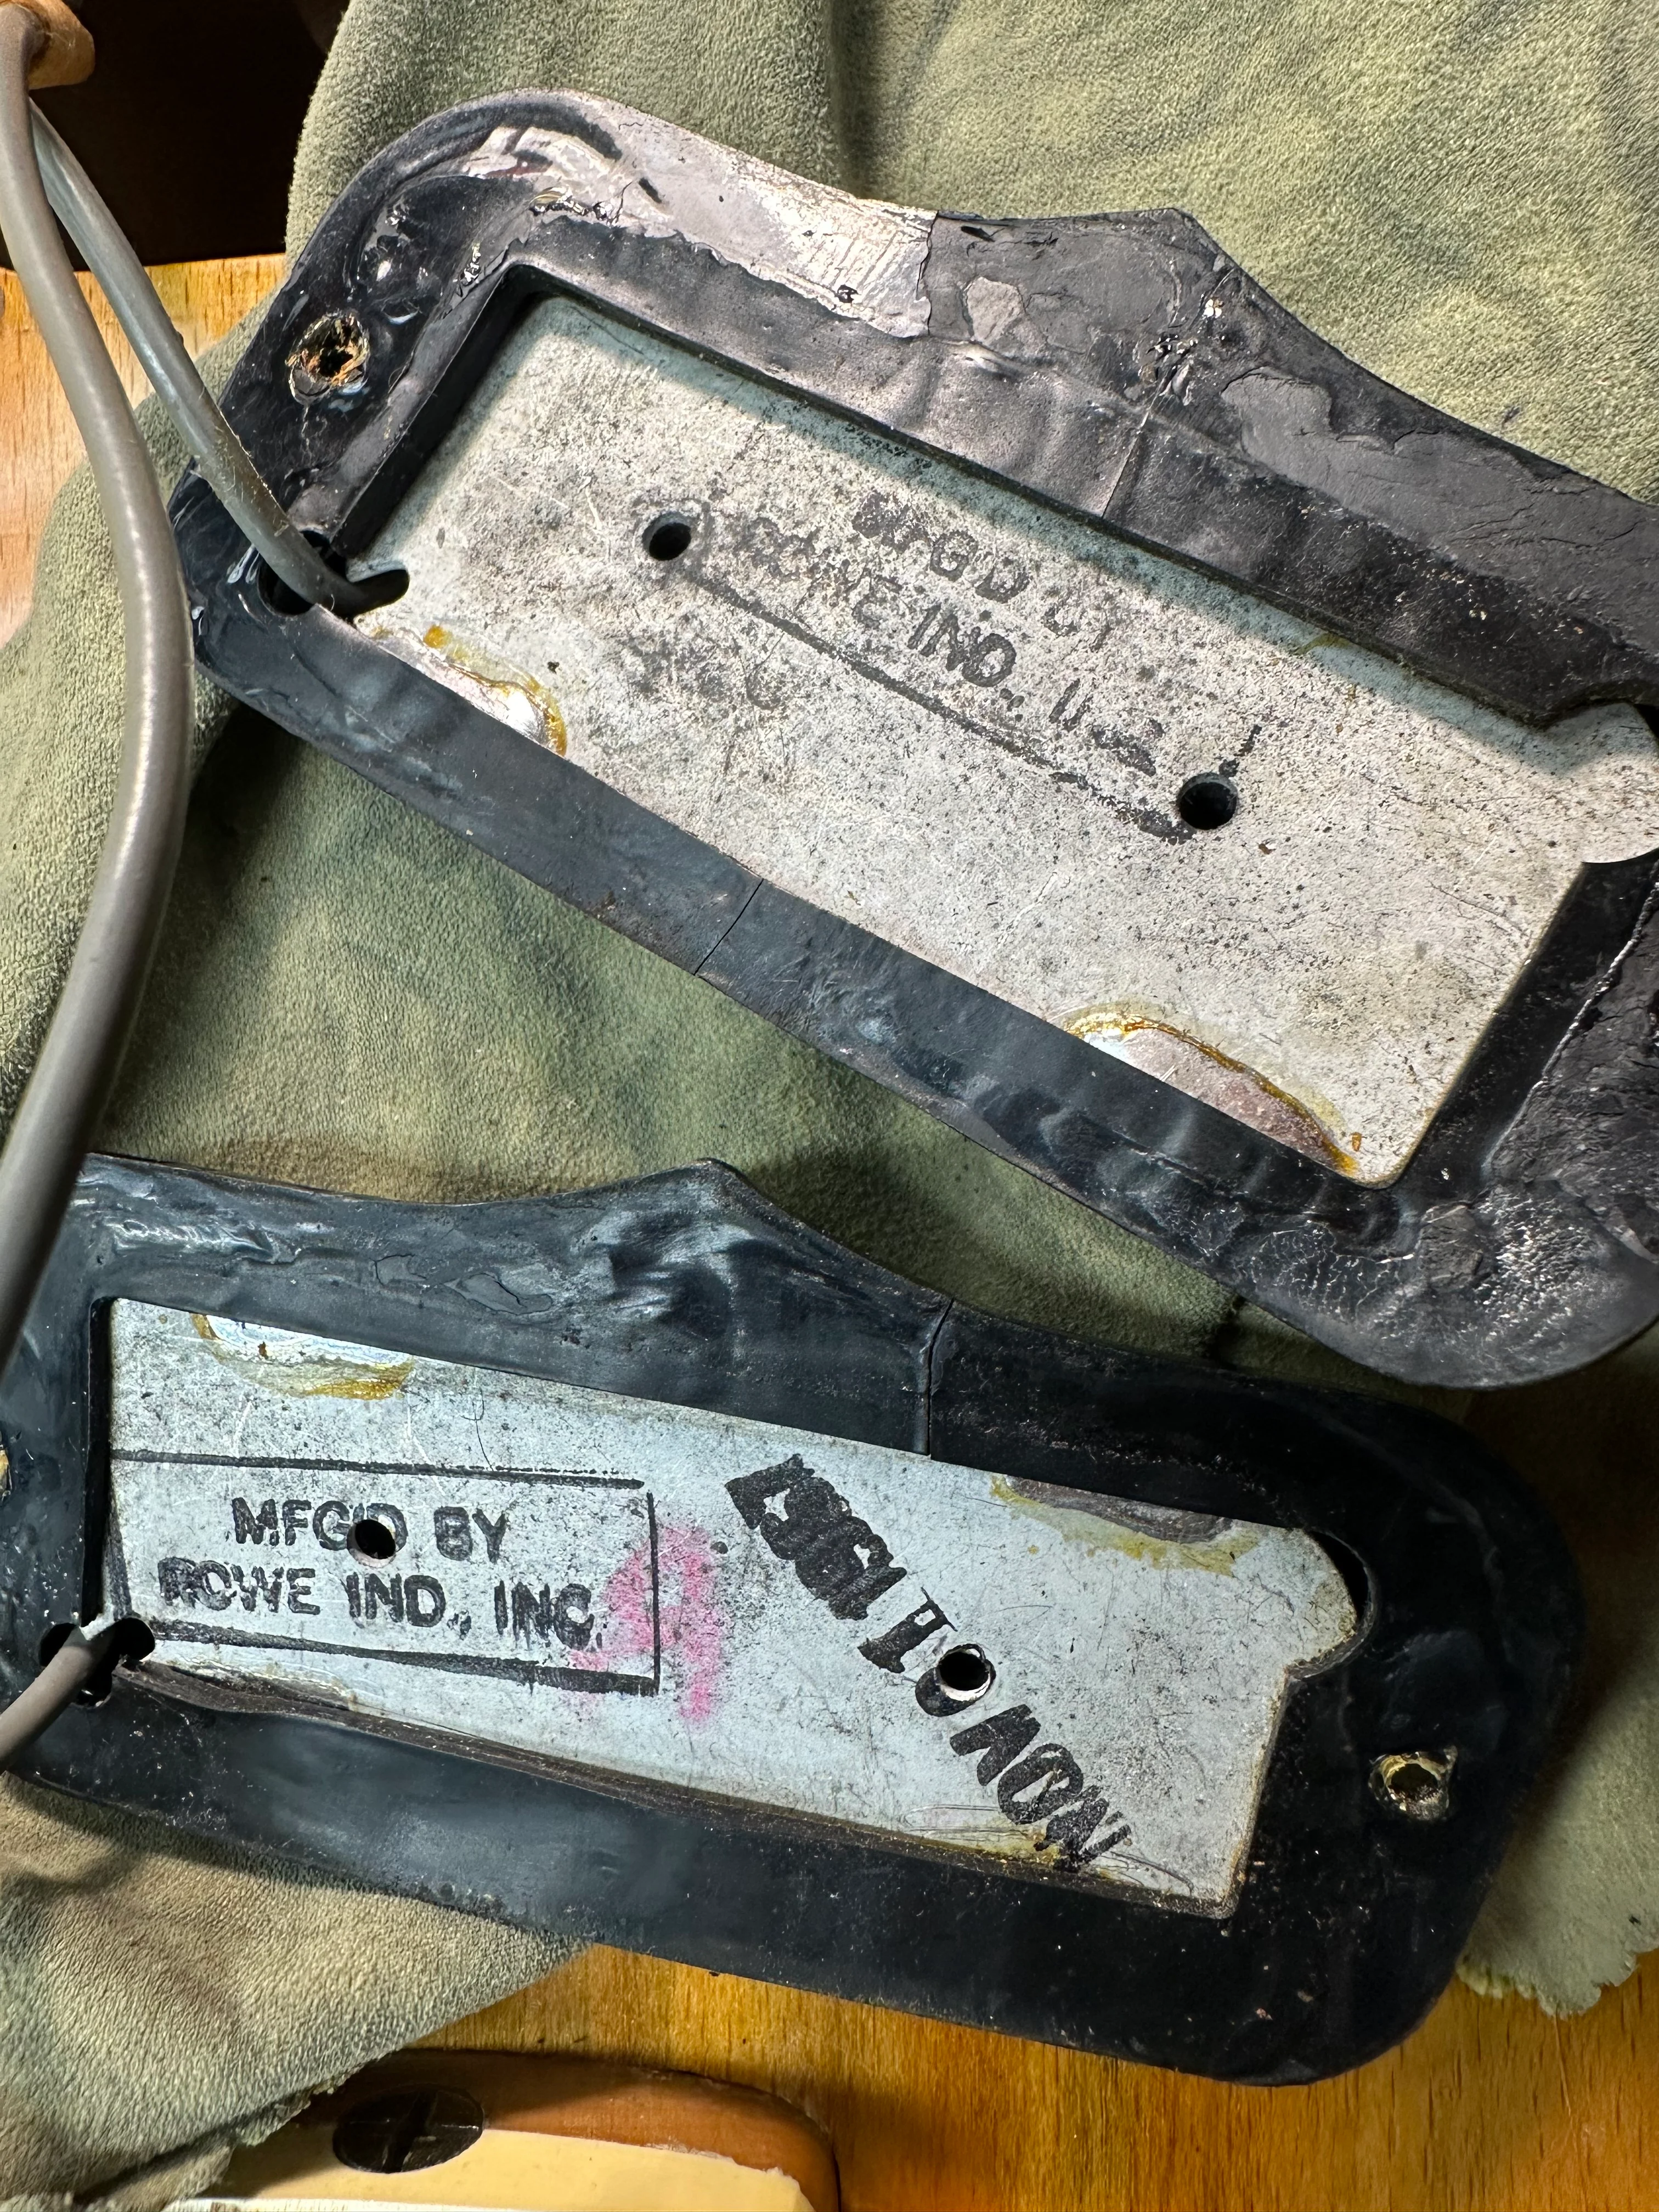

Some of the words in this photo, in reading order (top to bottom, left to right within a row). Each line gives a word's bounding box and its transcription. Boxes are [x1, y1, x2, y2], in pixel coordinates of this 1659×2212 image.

[433, 1506, 507, 1562] BY
[157, 1557, 320, 1615] ROWE
[950, 1704, 1131, 1872] NOV
